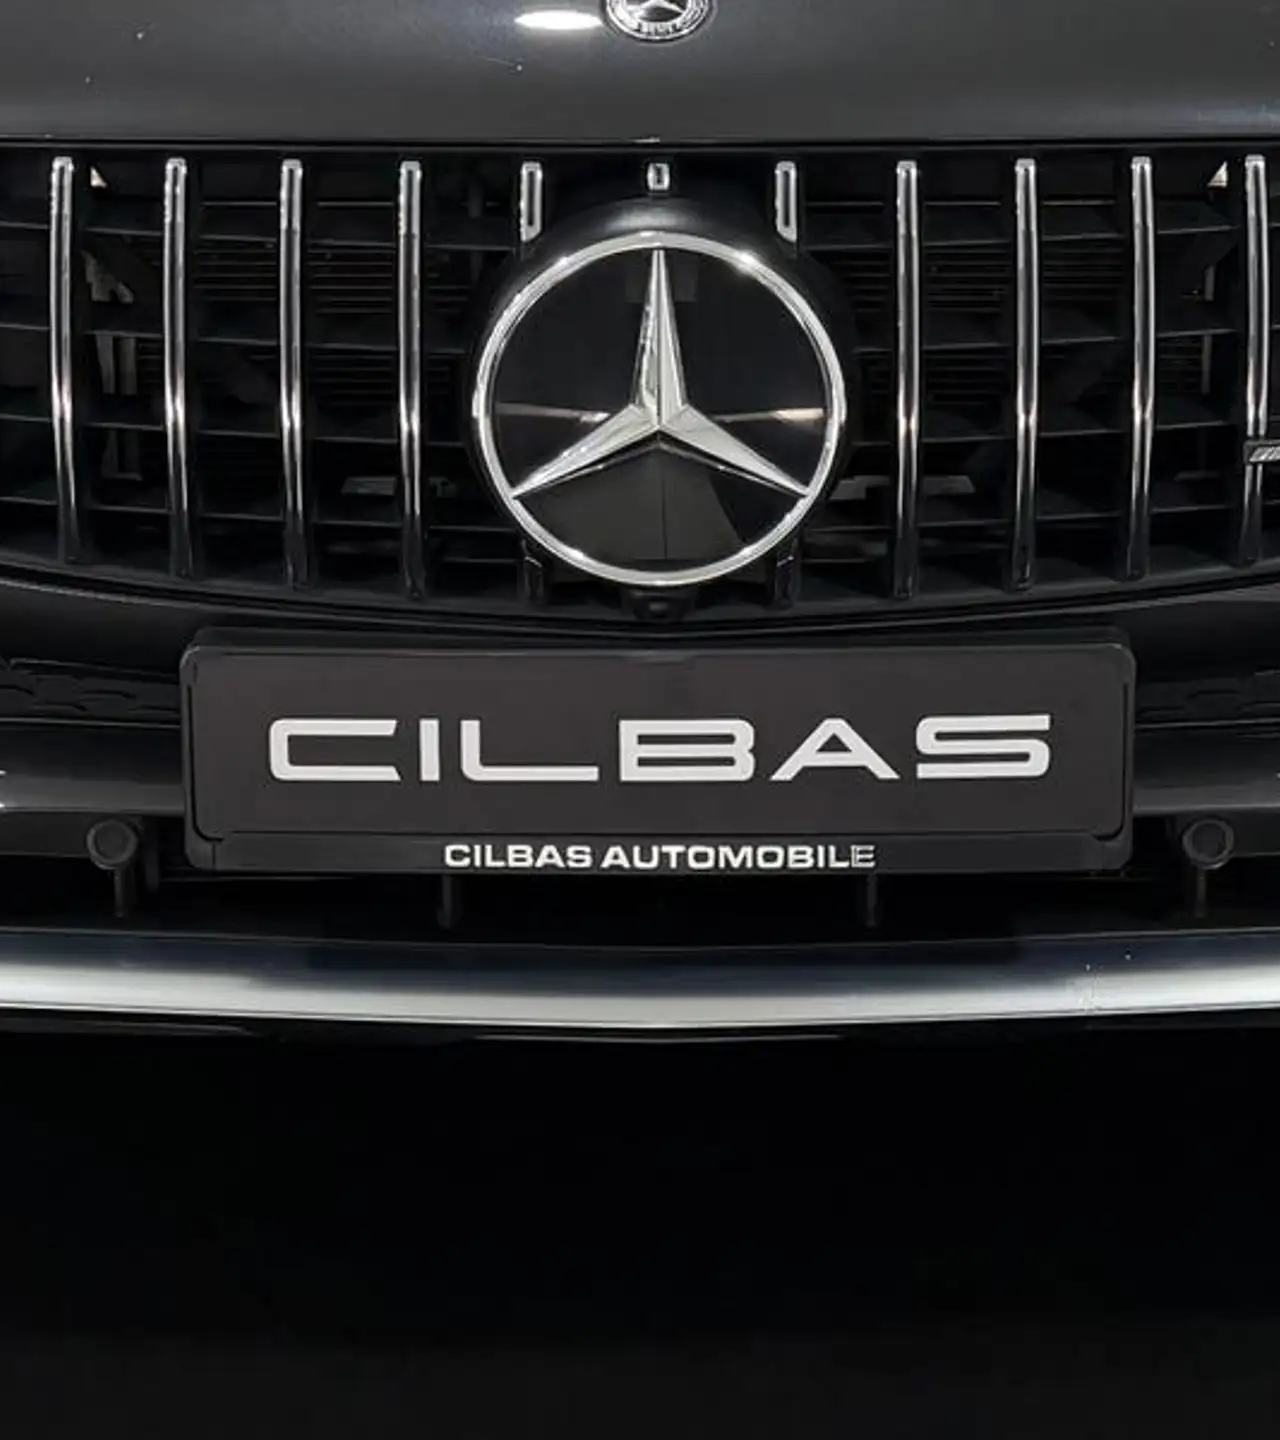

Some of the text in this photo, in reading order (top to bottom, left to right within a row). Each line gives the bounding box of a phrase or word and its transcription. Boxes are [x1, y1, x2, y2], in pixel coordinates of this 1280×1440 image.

[268, 713, 1051, 782] CILBAS
[443, 842, 876, 870] CILBAS AUTOMOBILE
